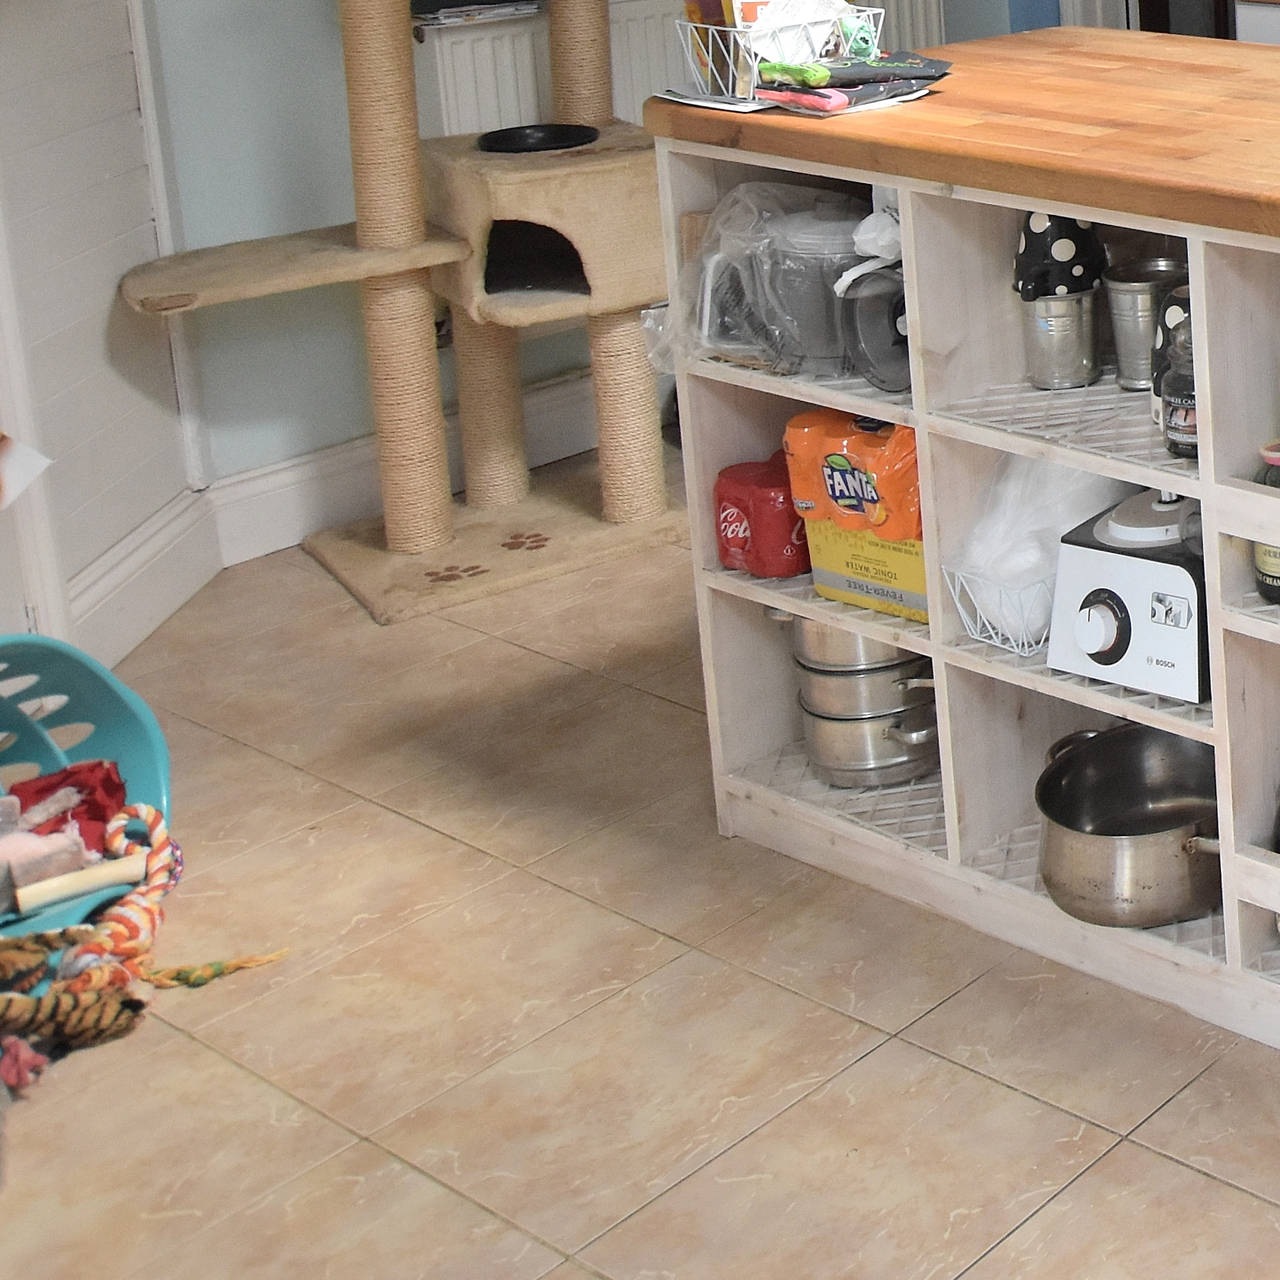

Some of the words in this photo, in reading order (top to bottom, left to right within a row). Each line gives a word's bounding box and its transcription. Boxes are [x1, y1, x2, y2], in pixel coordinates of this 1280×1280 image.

[822, 466, 879, 501] FANTA
[846, 579, 905, 601] FEVER-TREE
[1155, 659, 1176, 669] BOSCH
